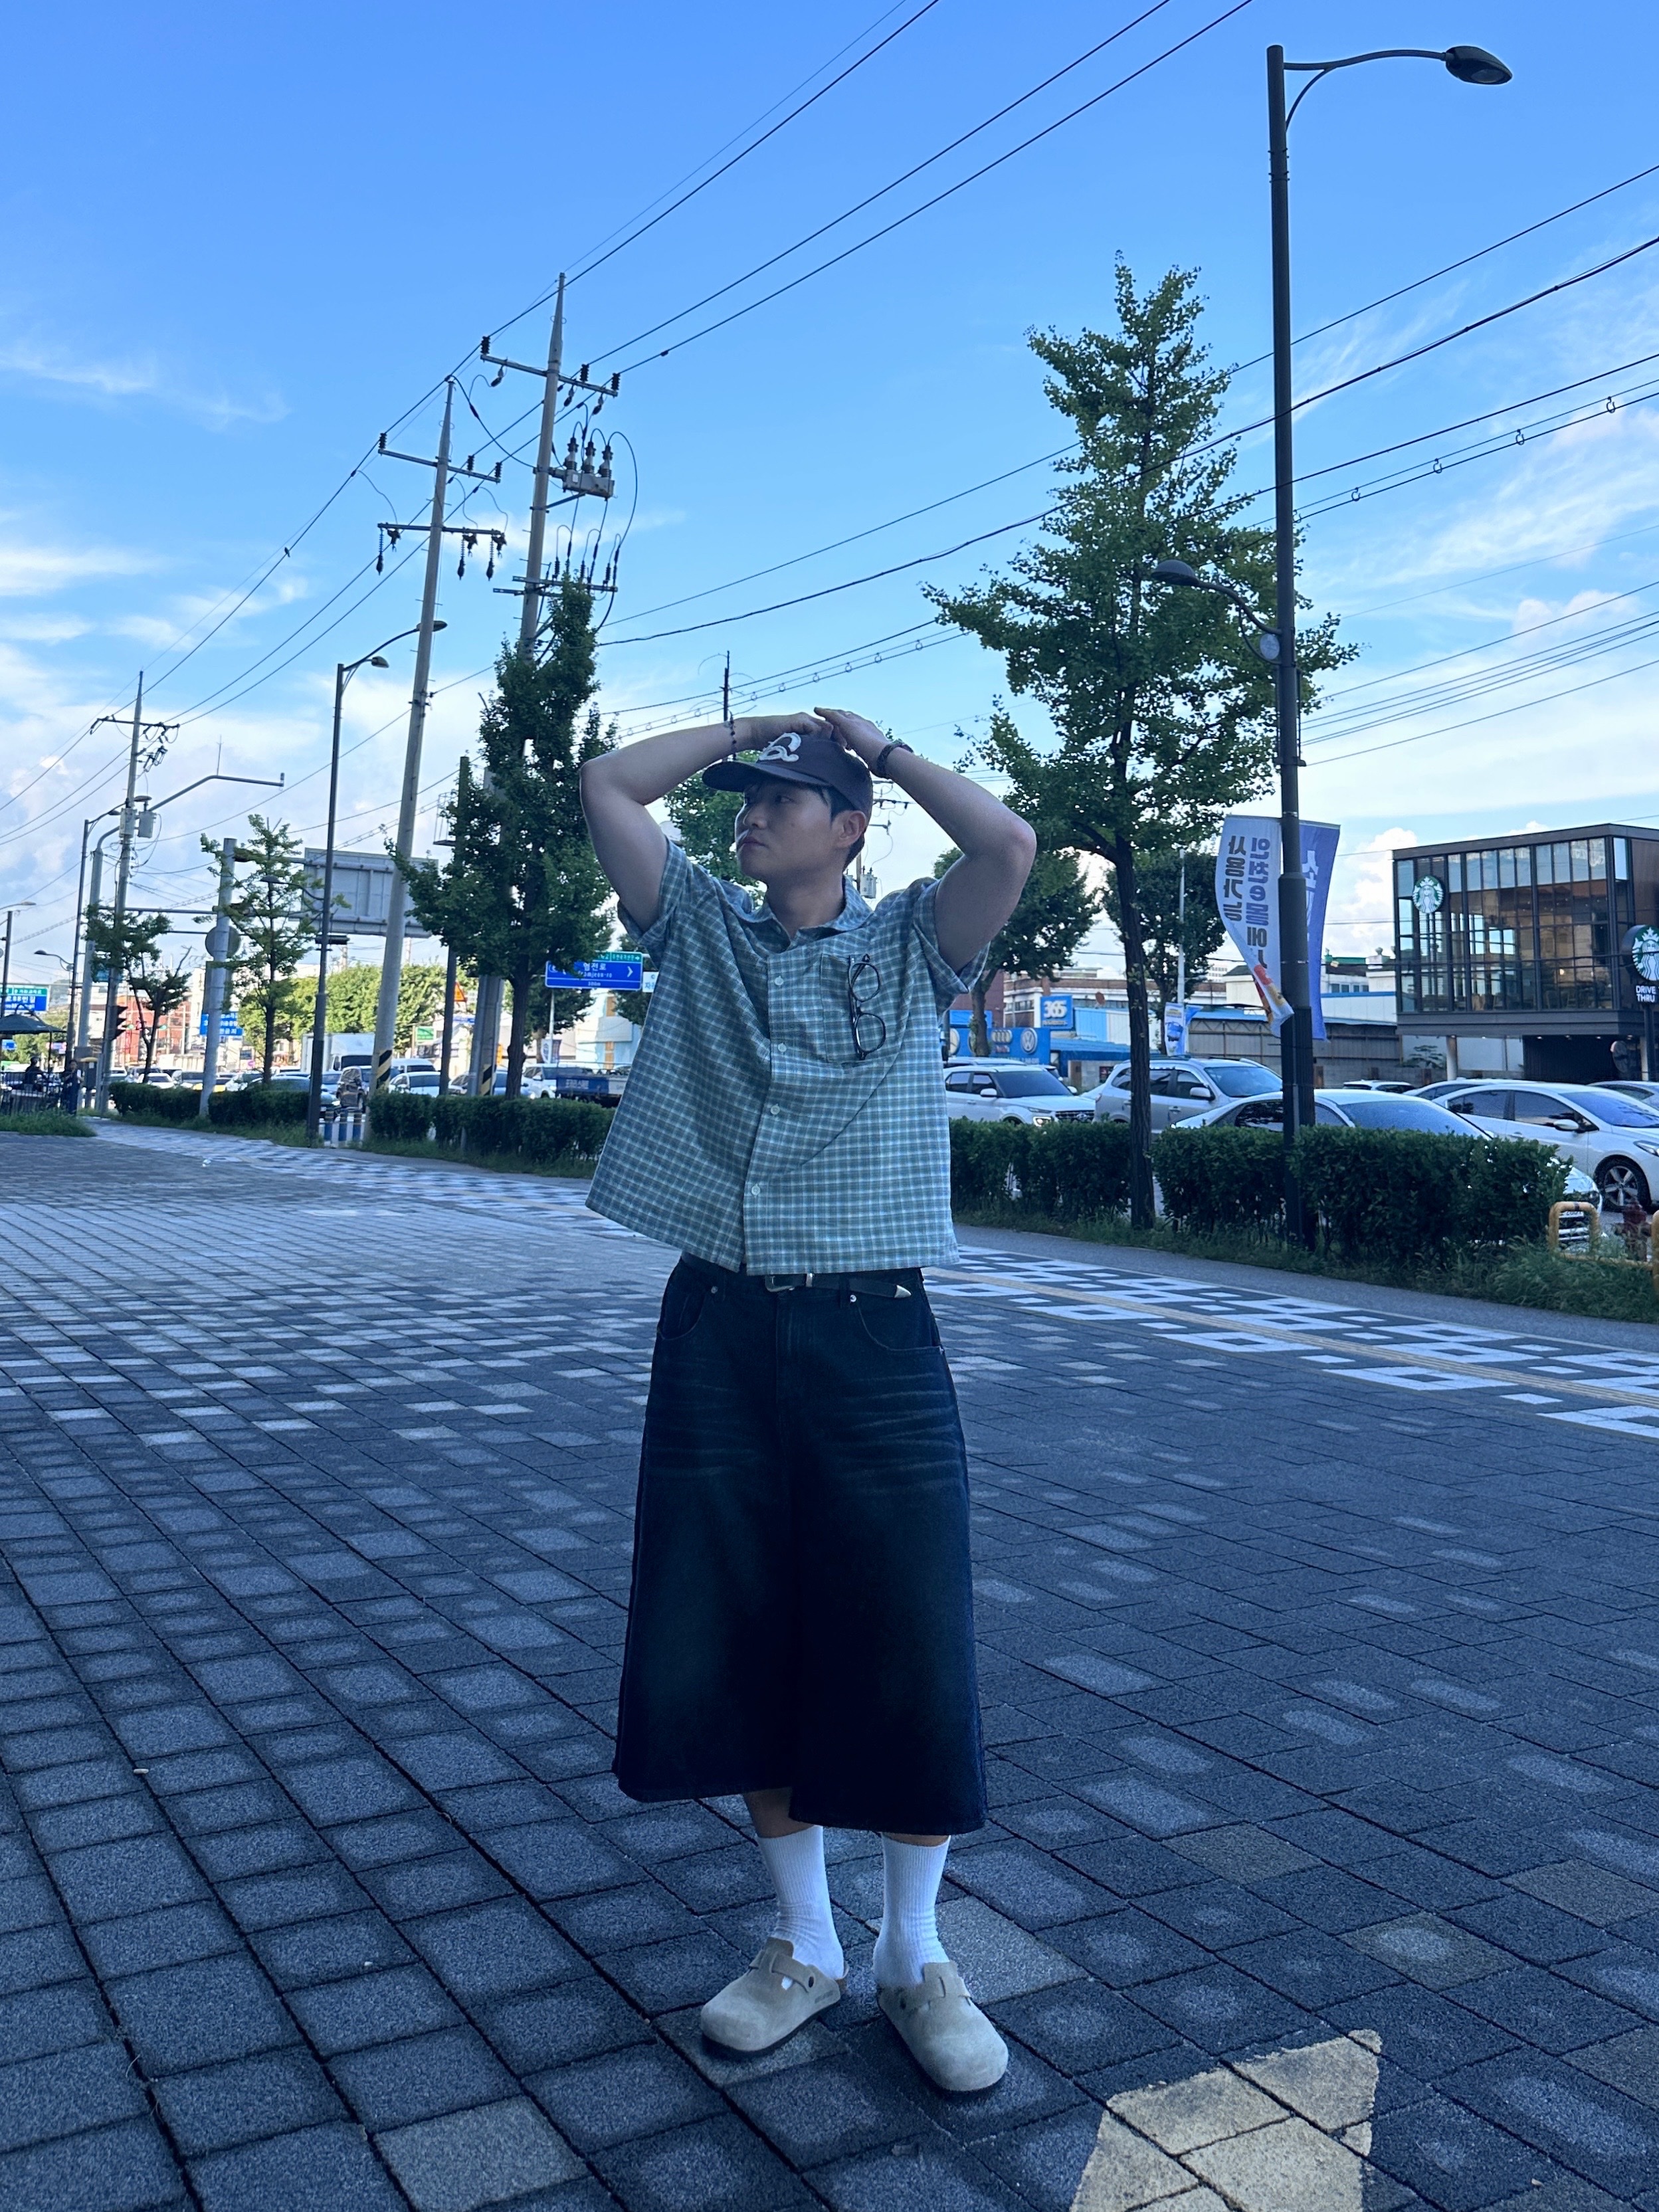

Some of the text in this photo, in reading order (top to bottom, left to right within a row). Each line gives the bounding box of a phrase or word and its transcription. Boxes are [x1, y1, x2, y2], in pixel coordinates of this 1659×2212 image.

[1636, 985, 1656, 995] DRIVE
[1636, 993, 1656, 1003] THRU
[1043, 1000, 1068, 1018] 365
